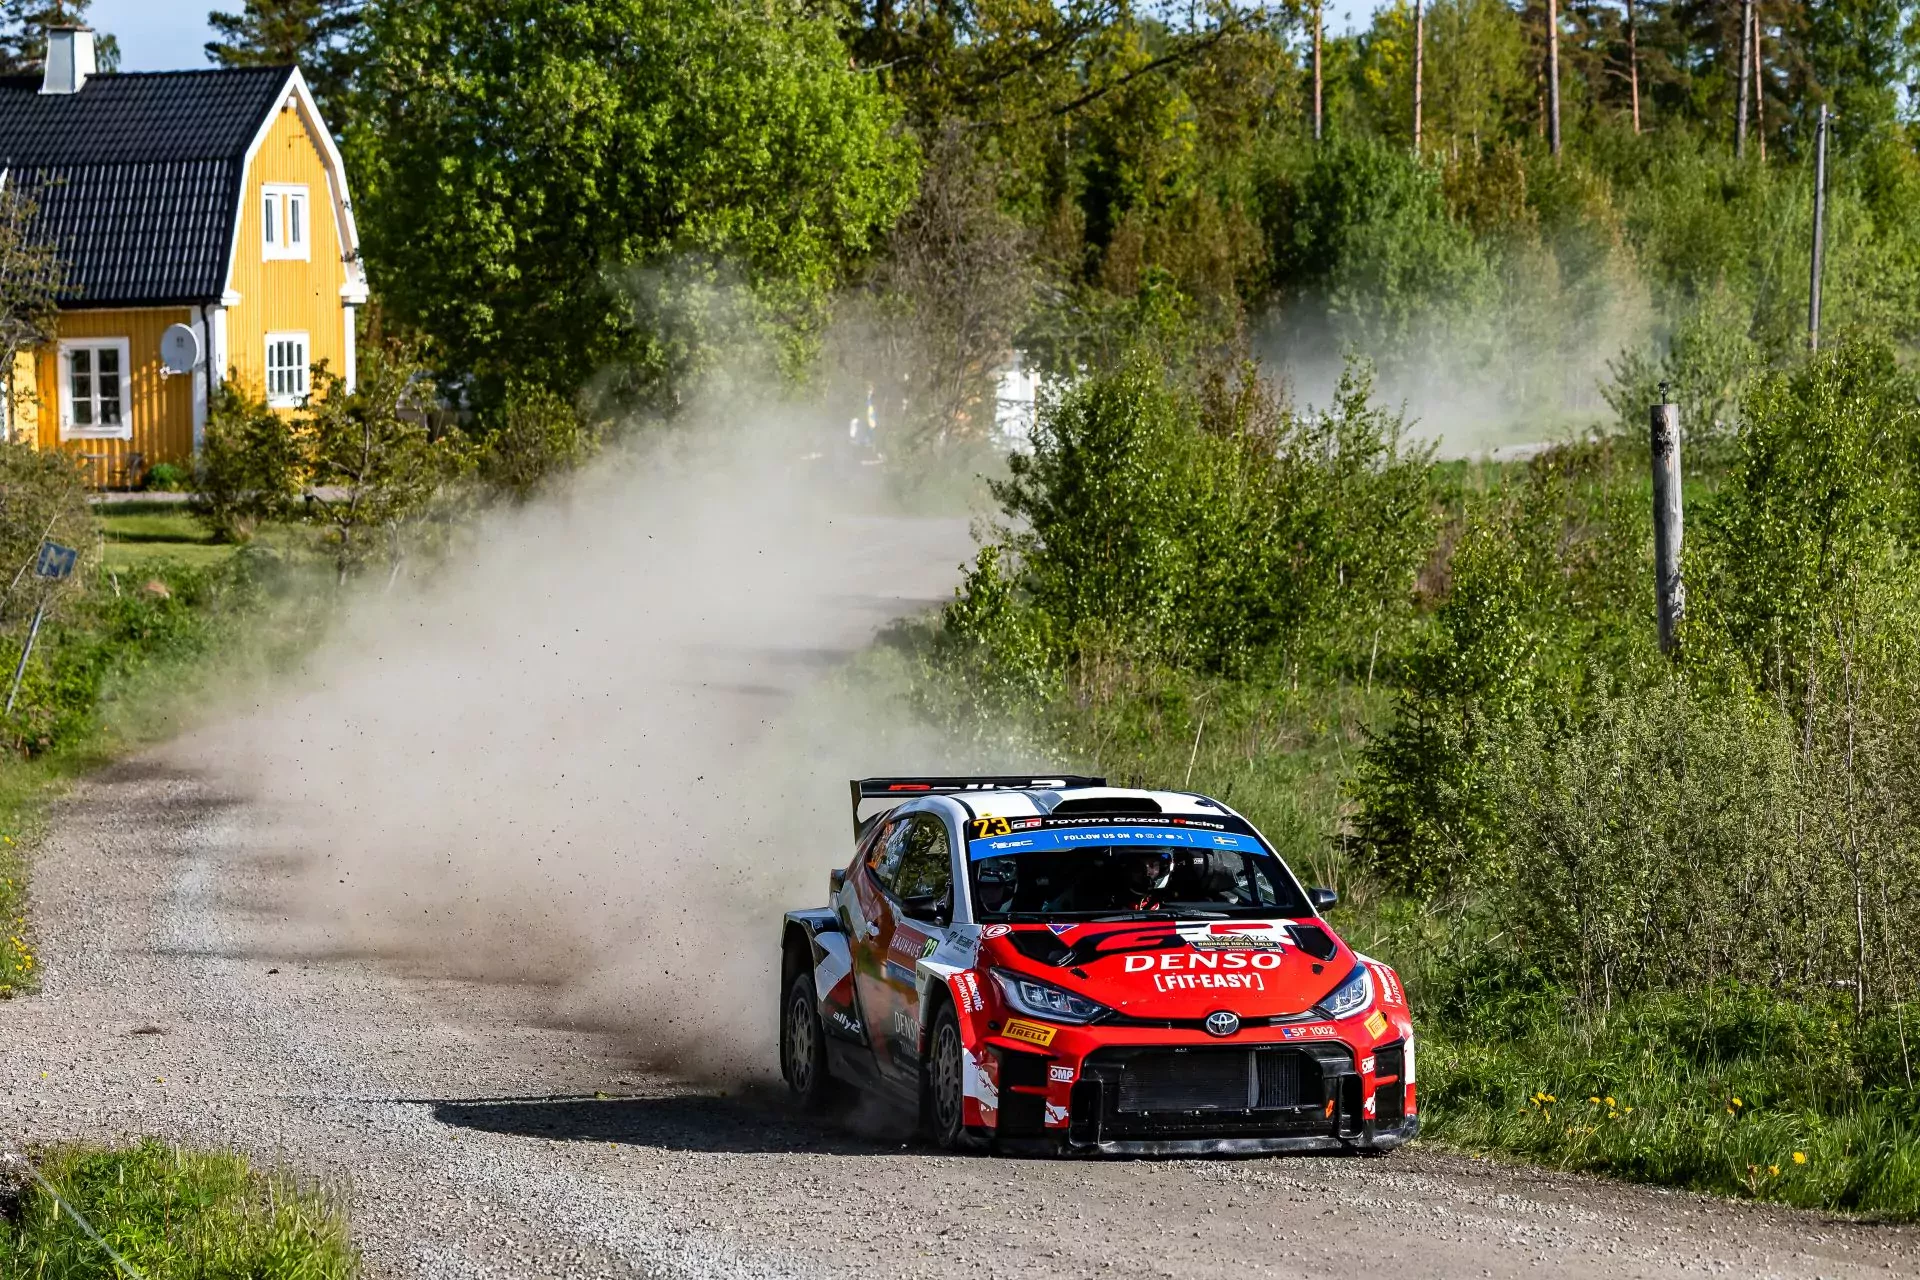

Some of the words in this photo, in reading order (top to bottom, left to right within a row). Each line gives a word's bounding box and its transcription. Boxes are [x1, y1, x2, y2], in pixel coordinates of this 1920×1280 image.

[41, 547, 69, 578] M
[973, 817, 1012, 838] 23
[1013, 820, 1041, 829] GR
[1173, 818, 1225, 830] Racing
[1063, 833, 1101, 841] FOLLOW
[890, 934, 921, 959] BAUHAUS
[1124, 953, 1282, 973] DENSO
[963, 972, 984, 1011] Panasonic
[1007, 1022, 1050, 1042] PIRELLI
[1290, 1028, 1307, 1036] SP
[1310, 1026, 1335, 1035] 1002
[1050, 1068, 1074, 1081] OMP
